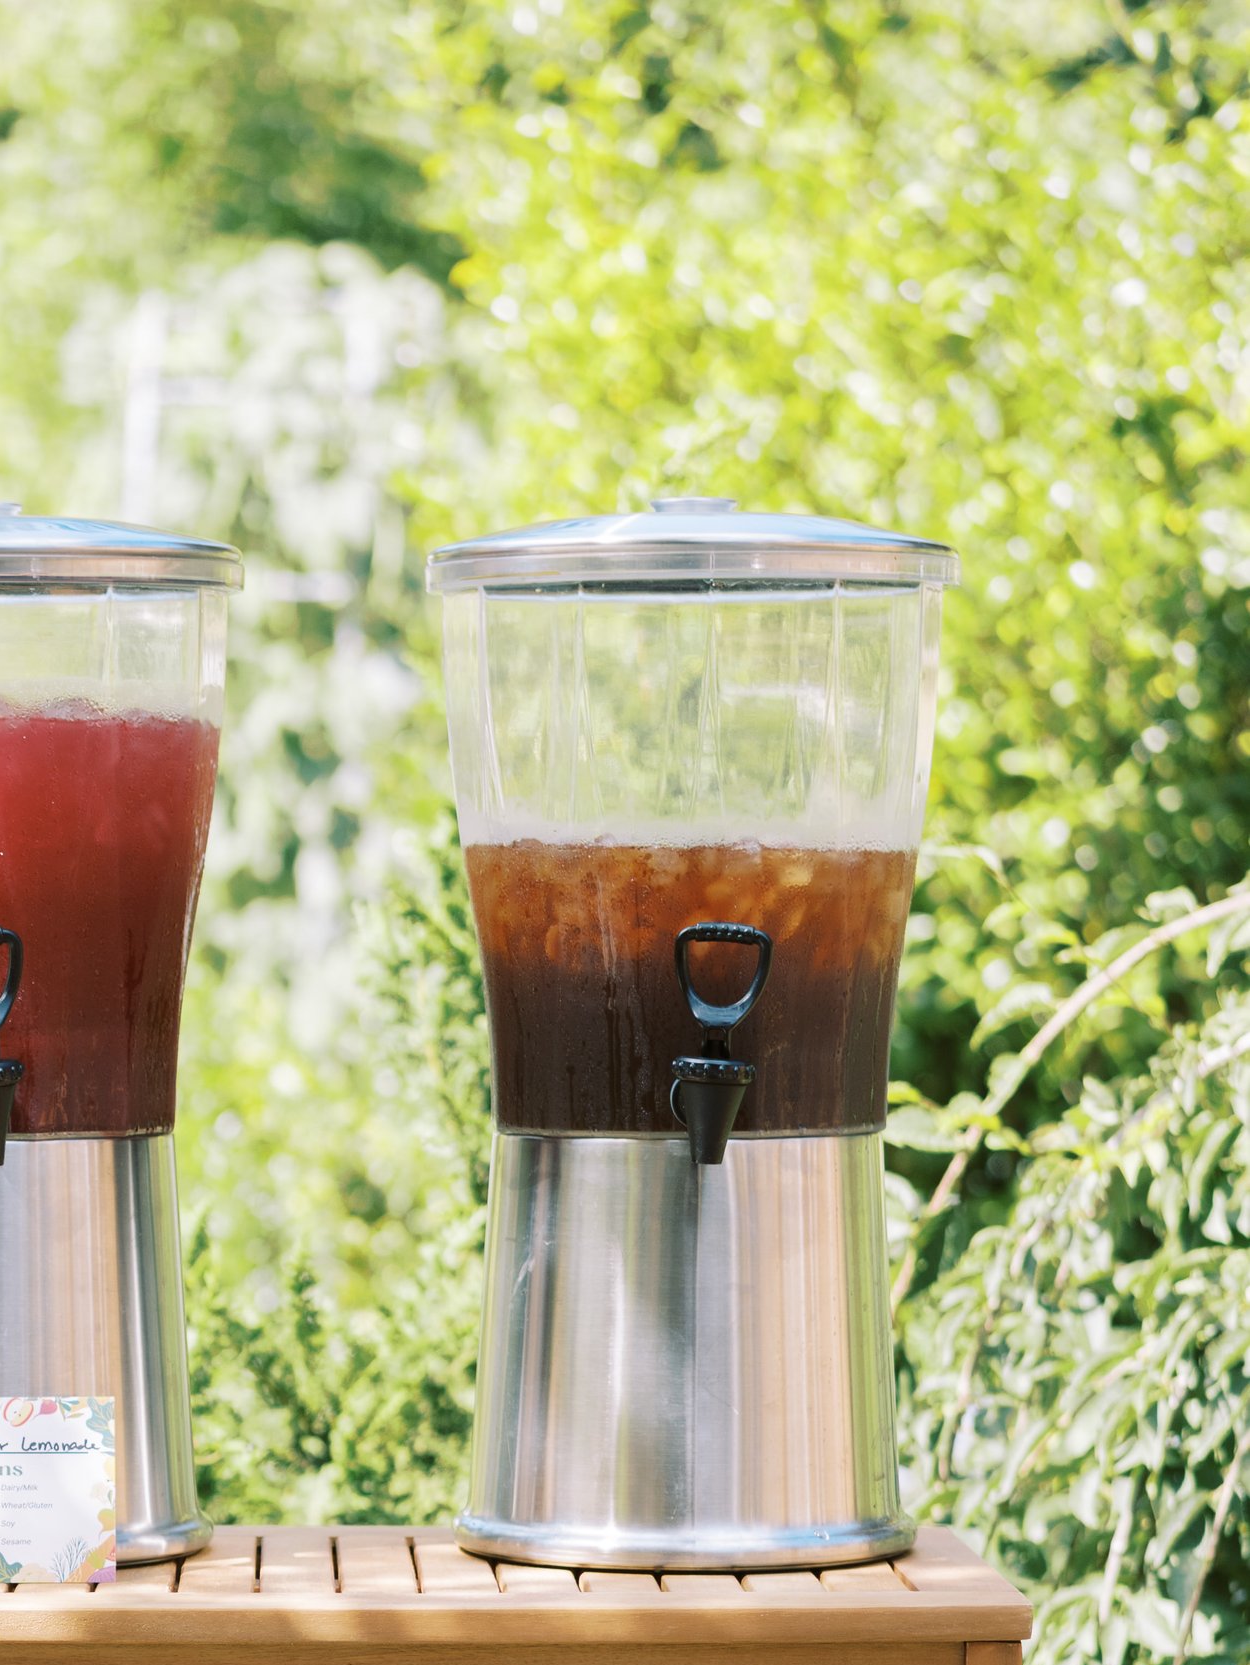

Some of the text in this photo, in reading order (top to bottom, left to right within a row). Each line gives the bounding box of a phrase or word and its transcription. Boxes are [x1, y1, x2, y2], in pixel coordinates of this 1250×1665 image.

[0, 1483, 38, 1493] Dairy/Milk
[0, 1501, 53, 1510] Wheat/Gluten
[0, 1519, 15, 1529] Soy
[0, 1537, 32, 1546] Sesame
